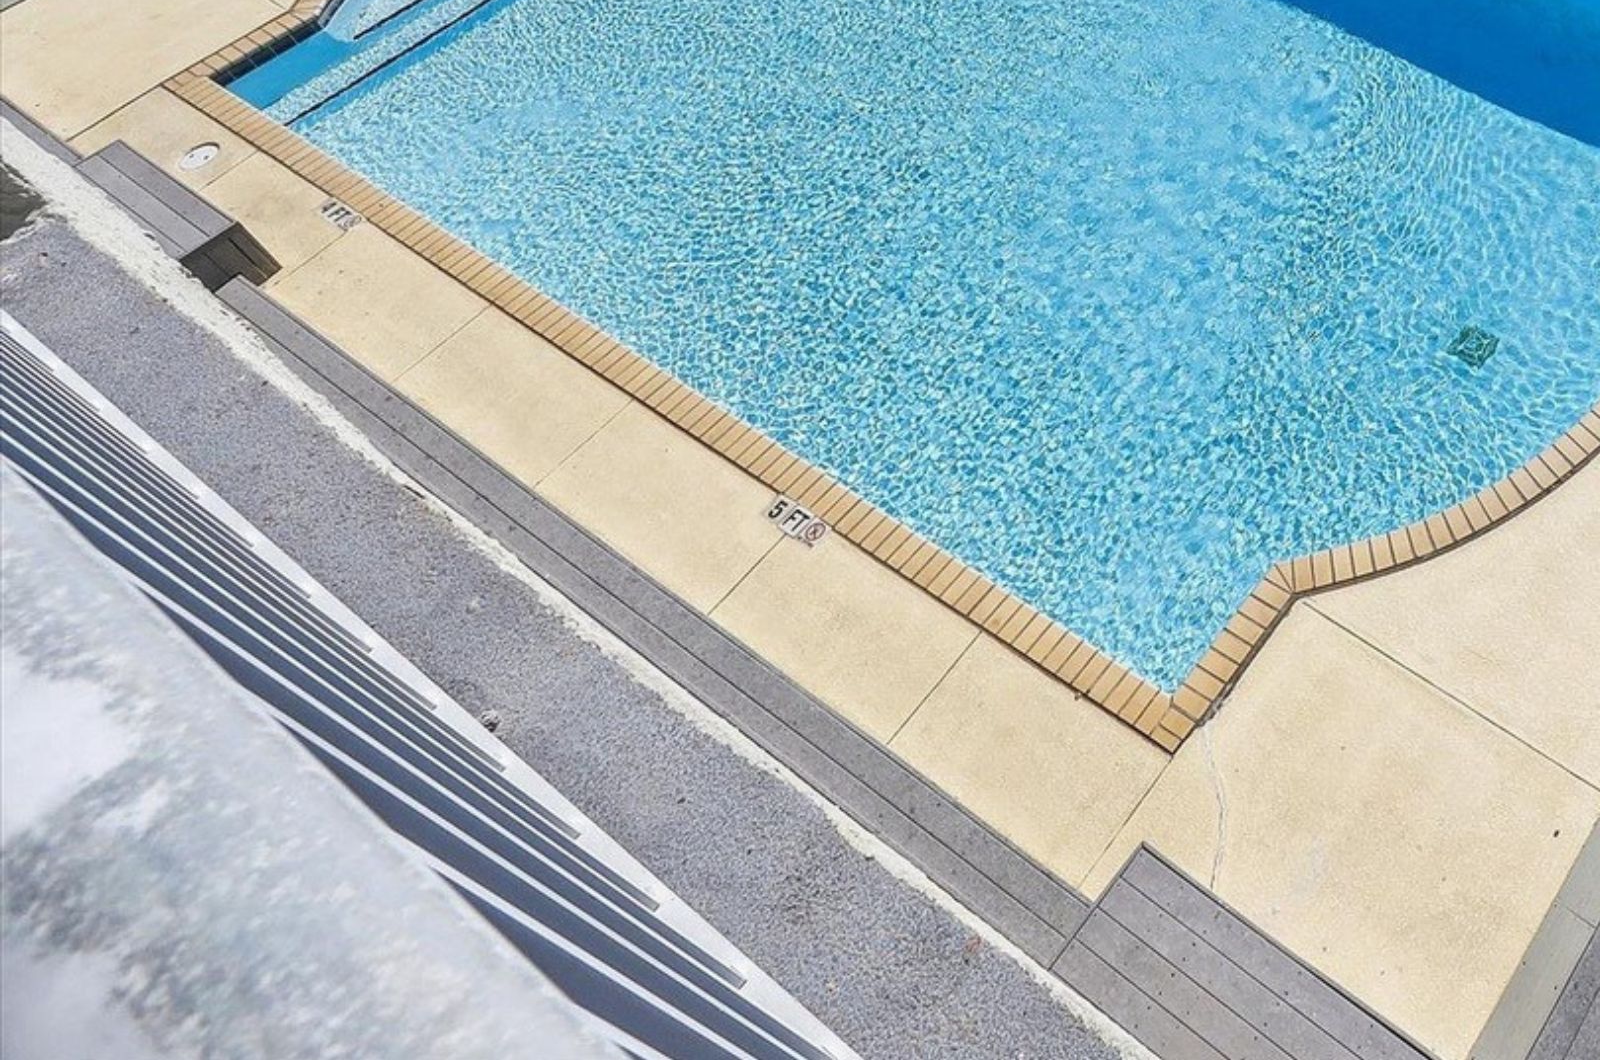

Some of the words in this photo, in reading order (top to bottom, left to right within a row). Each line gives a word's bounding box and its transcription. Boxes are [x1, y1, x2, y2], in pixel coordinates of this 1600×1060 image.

[327, 206, 352, 222] FT
[767, 500, 789, 519] 5
[782, 508, 810, 532] FT
